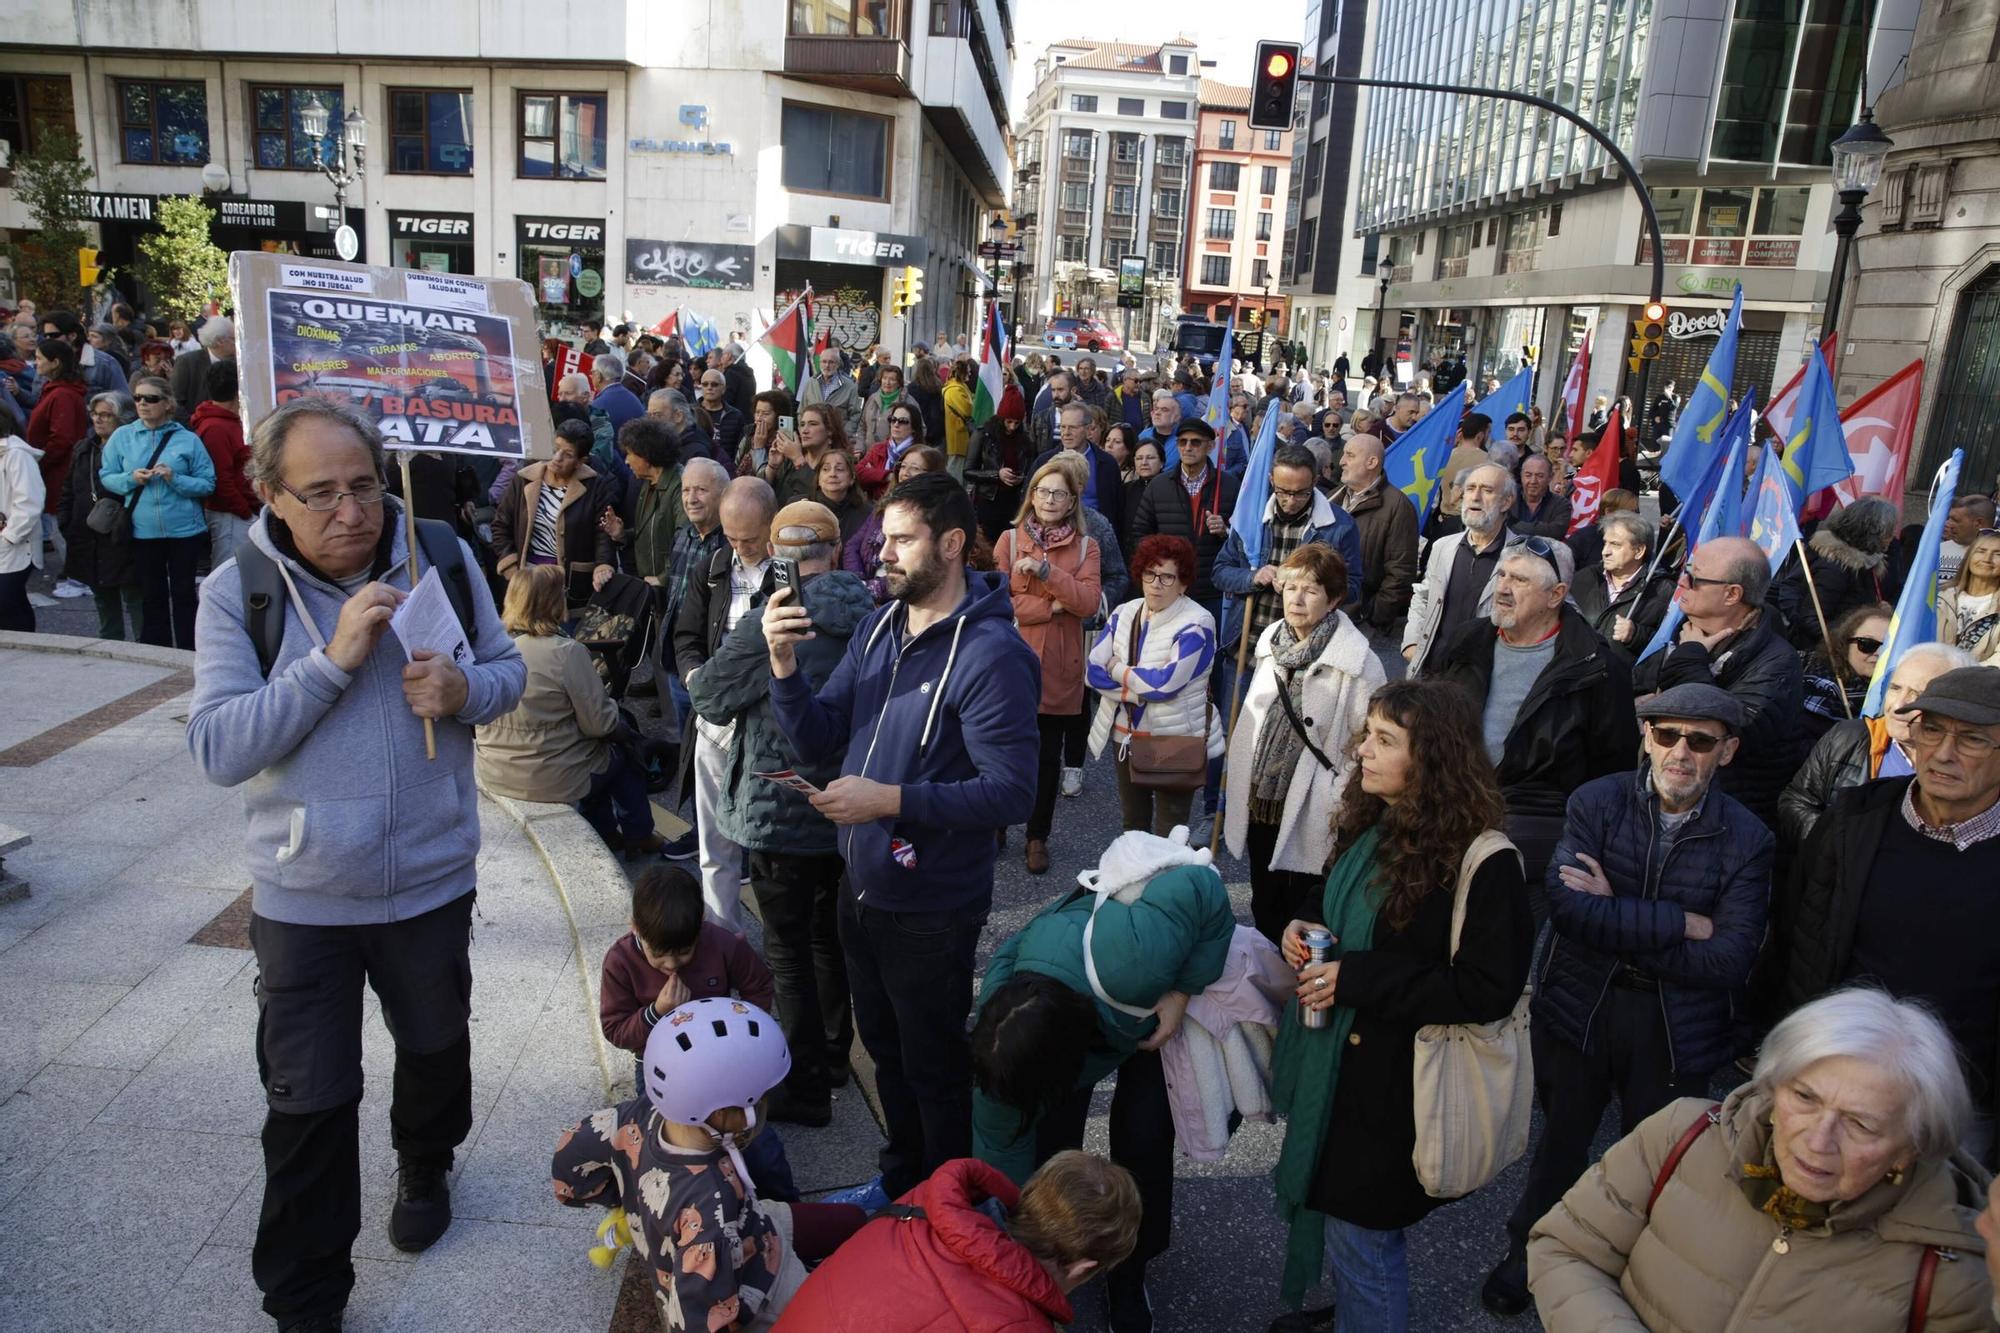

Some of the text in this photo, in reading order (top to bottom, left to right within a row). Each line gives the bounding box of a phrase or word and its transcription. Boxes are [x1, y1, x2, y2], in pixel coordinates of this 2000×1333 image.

[222, 202, 275, 216] KOREAN BBQ
[222, 215, 276, 227] BUFFET LIBRE
[397, 217, 470, 234] TIGER
[525, 222, 601, 241] TIGER
[835, 238, 905, 258] TIGER
[307, 271, 338, 281] NUESTRA
[341, 275, 364, 284] SALUD
[407, 273, 443, 284] QUEREMOS
[455, 280, 485, 290] CONCEJO
[428, 283, 467, 294] SALUDABLE
[303, 299, 477, 333] QUEMAR
[297, 325, 341, 342] DIOXINAS
[369, 342, 418, 355] FURANOS
[429, 351, 480, 361] ABORTOS
[292, 360, 348, 372] CANCERES
[367, 367, 448, 377] MALFORMACIONES
[382, 396, 518, 426] BASURA
[378, 416, 496, 448] ATA
